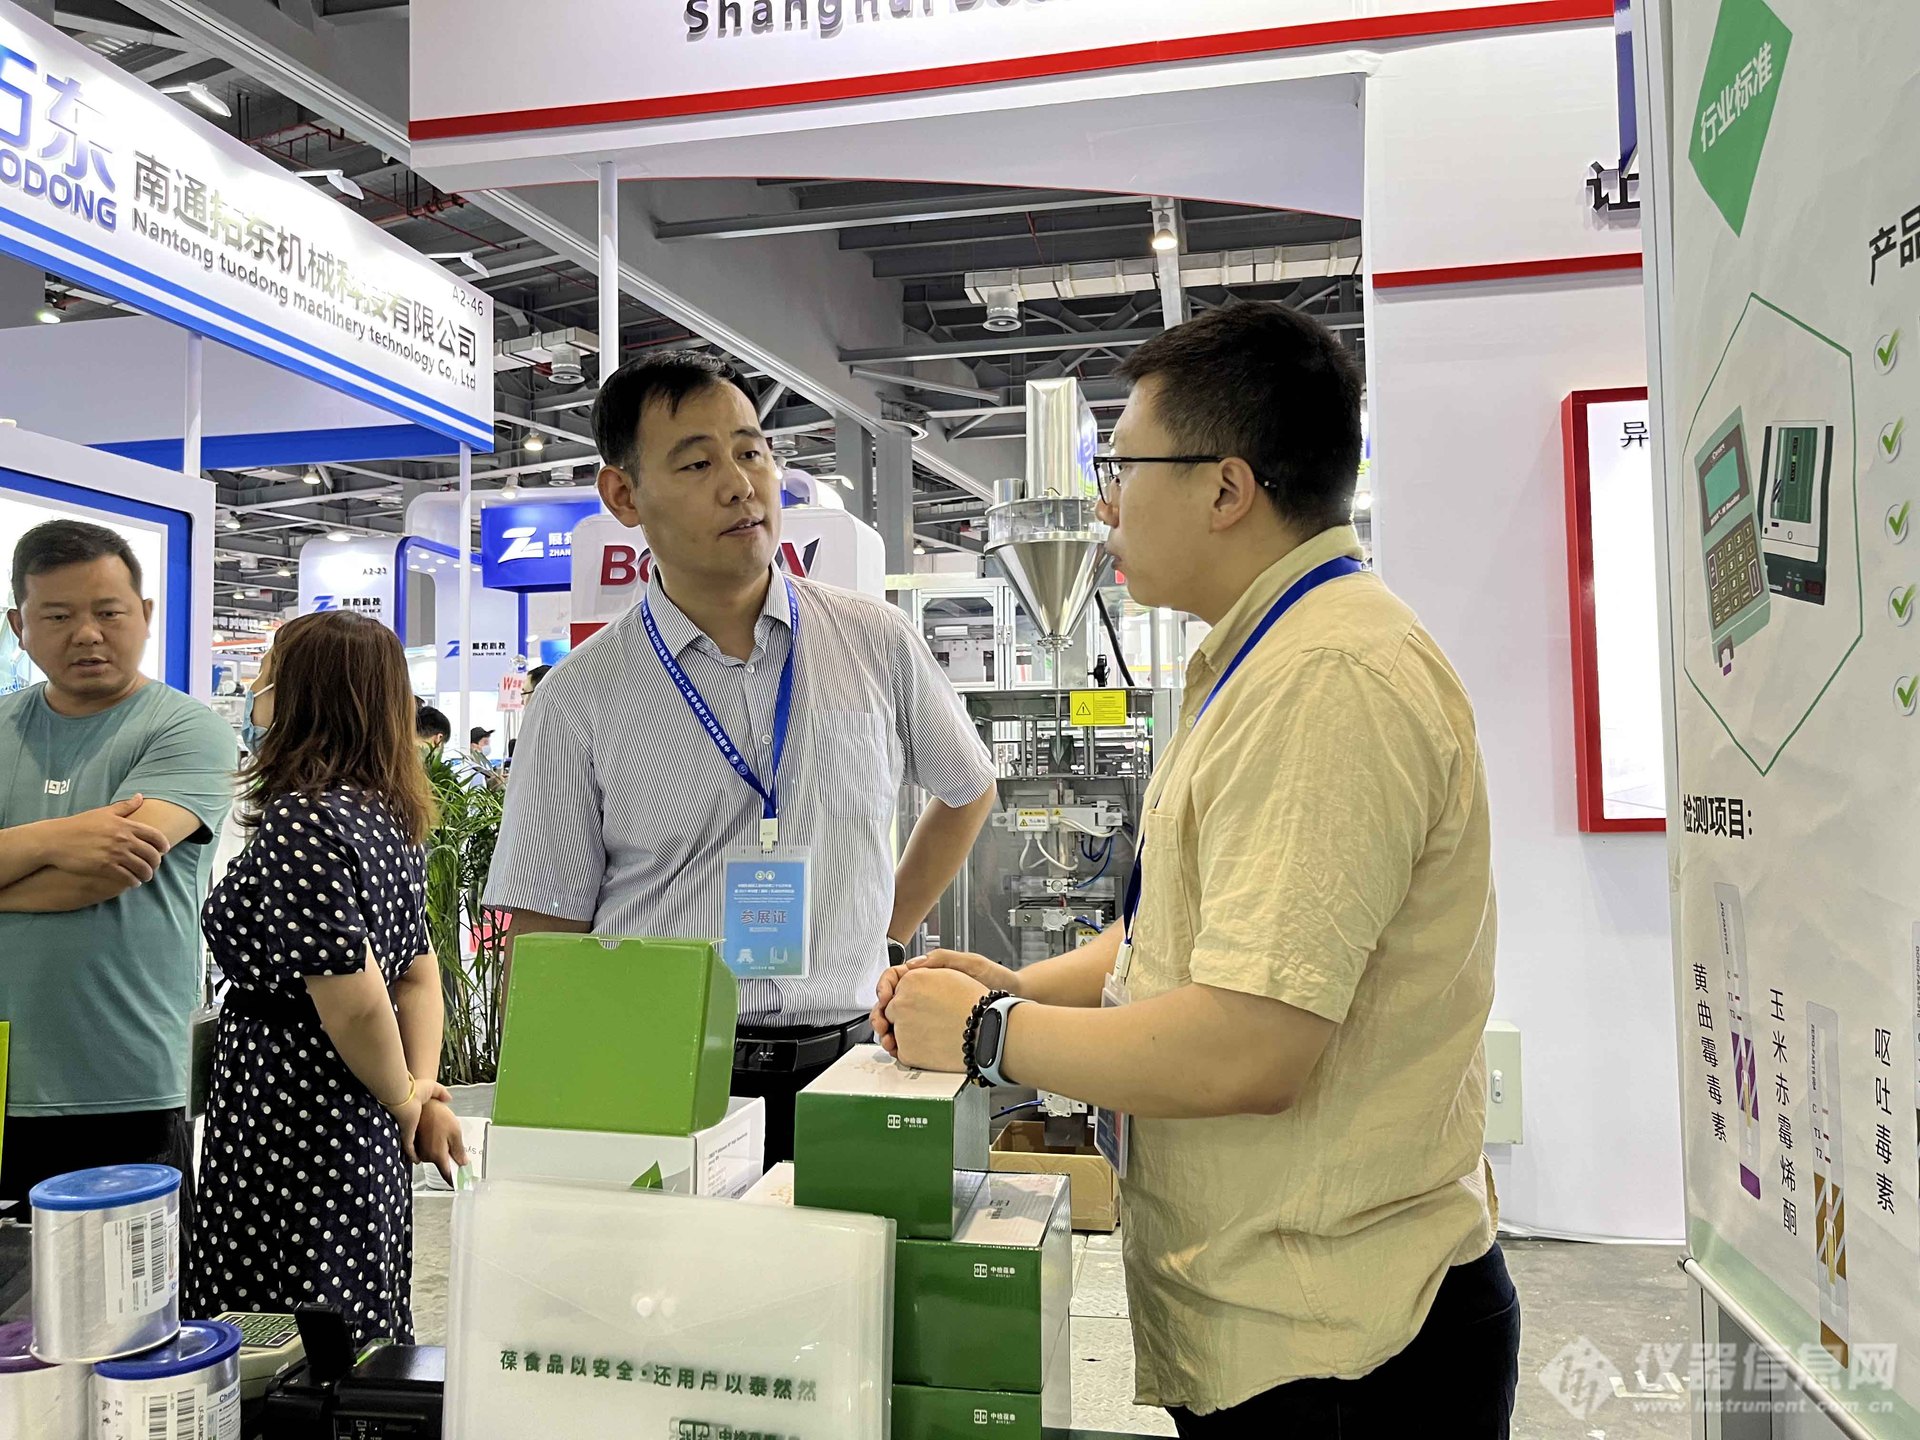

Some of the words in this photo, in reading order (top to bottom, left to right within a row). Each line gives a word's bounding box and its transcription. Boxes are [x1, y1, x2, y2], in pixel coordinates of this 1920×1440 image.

[1701, 41, 1772, 153] 行业标准
[132, 208, 214, 272] Nantong
[219, 252, 288, 305] tuodong
[294, 290, 366, 341] machinery
[370, 325, 435, 374] technology
[461, 368, 476, 390] Ltd
[453, 285, 484, 317] A2-46
[741, 909, 787, 925] 参展证
[1693, 962, 1728, 1143] 黄曲霉毒素
[1770, 988, 1797, 1236] 玉米赤霉烯酮
[1814, 1127, 1821, 1140] T1
[1815, 1147, 1823, 1159] T2
[1875, 1027, 1895, 1215] 呕吐毒素
